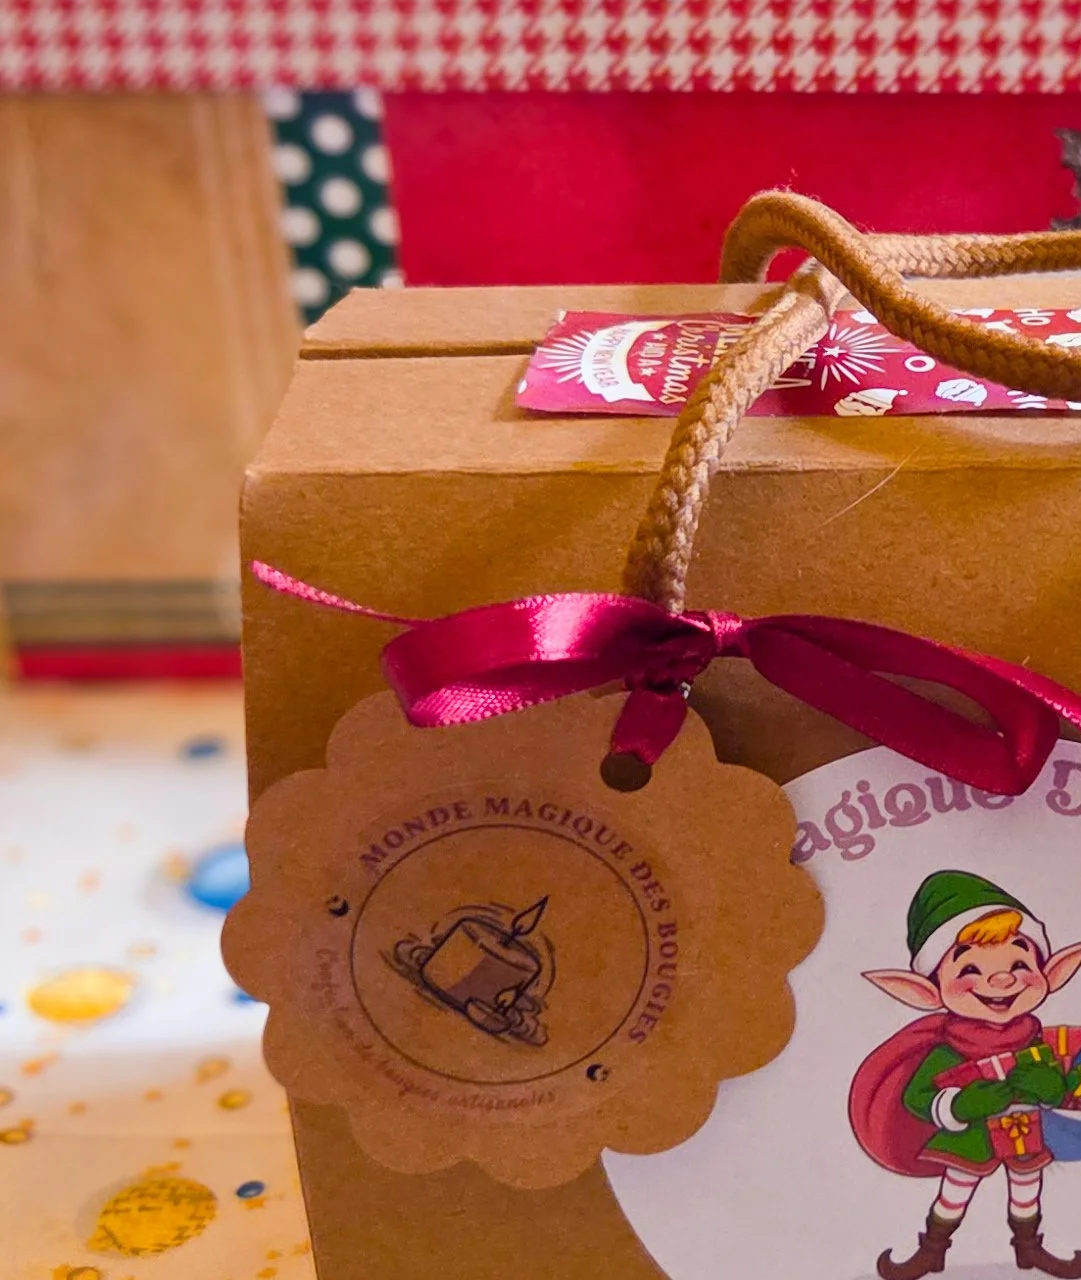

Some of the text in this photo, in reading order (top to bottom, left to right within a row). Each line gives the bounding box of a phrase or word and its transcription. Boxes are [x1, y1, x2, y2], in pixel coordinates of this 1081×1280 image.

[659, 320, 724, 405] Christmas
[790, 776, 1014, 864] agique
[360, 797, 678, 1045] MONDE MAGIQUE DES BOUGIES
